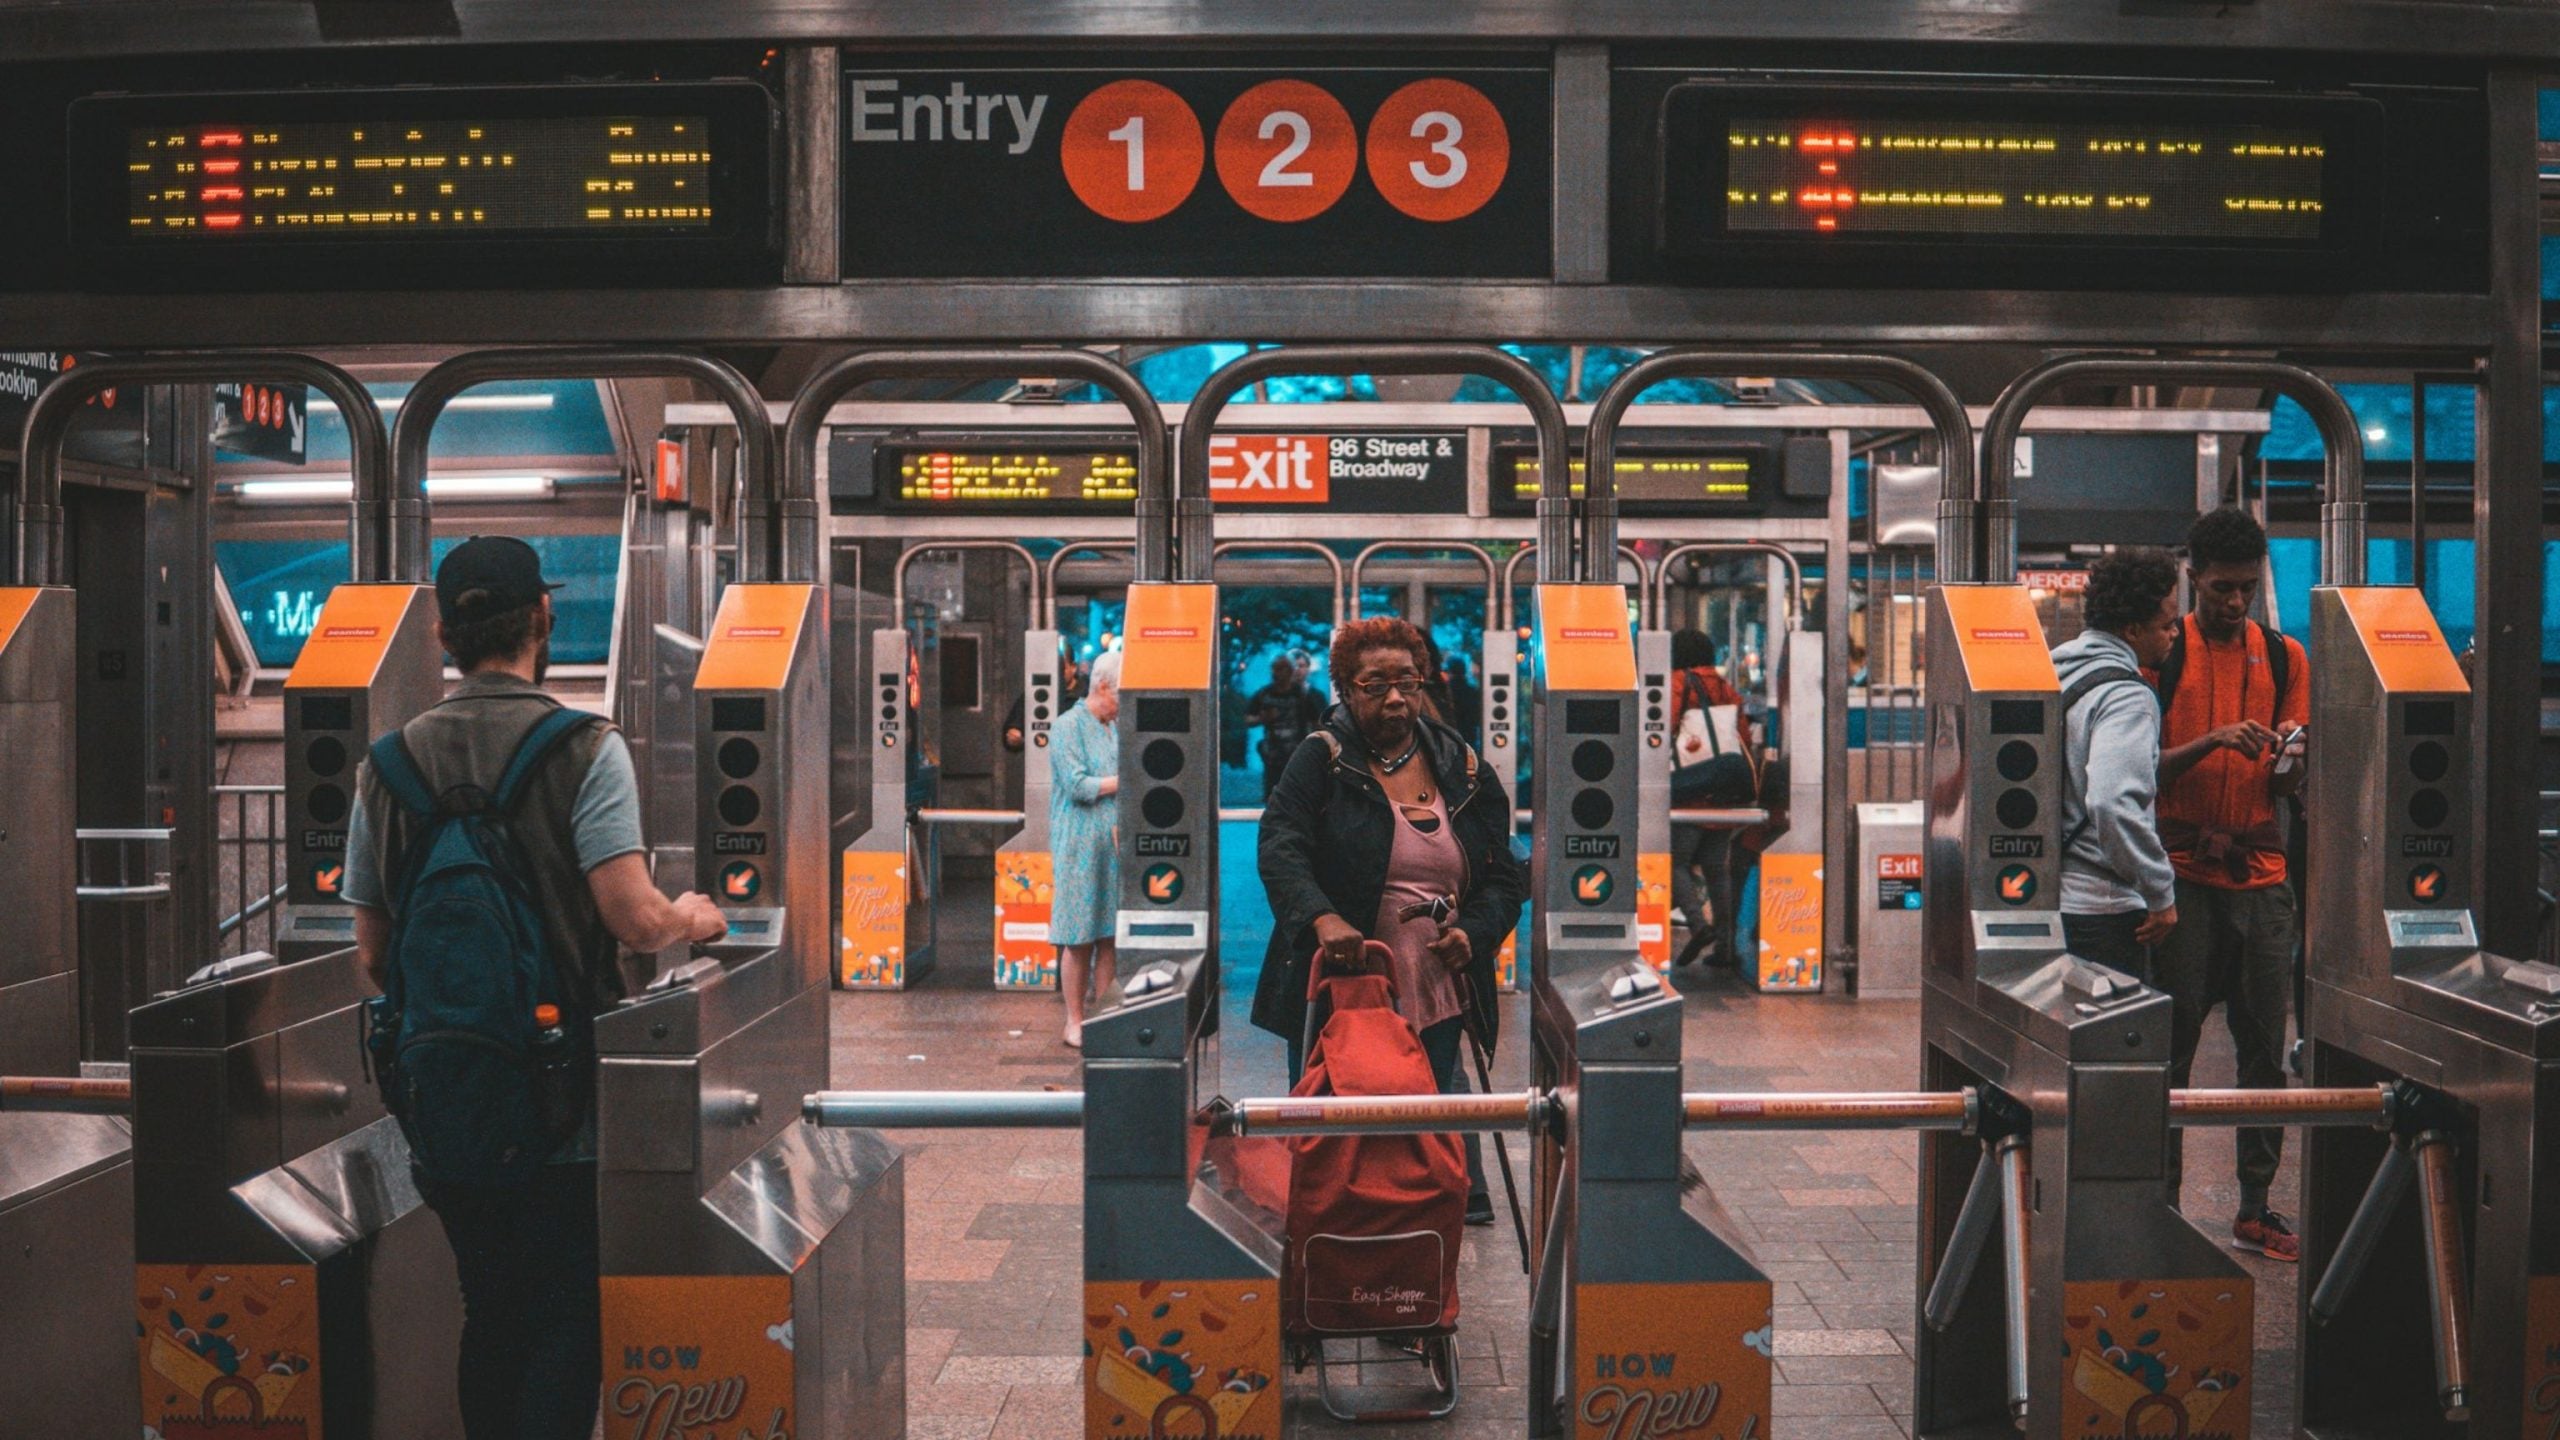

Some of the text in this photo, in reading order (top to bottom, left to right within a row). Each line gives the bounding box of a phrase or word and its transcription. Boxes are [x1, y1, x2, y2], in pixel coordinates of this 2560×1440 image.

[852, 79, 1469, 191] Entry 1 2 3
[1209, 437, 1453, 490] Exit 96 Street &
[1329, 459, 1430, 481] Broadway
[715, 834, 764, 854] Entry
[1138, 836, 1188, 856] Entry
[1567, 837, 1617, 857] Entry
[1992, 837, 2040, 857] Entry
[2404, 837, 2450, 856] Entry
[1881, 857, 1918, 875] Exit
[1334, 1106, 1383, 1117] ORDER
[1391, 1104, 1431, 1115] WITH
[1772, 1103, 1824, 1112] ORDER
[1352, 1285, 1427, 1306] Easy Shopper
[1396, 1305, 1417, 1314] GNA
[624, 1346, 700, 1370] HOW
[1596, 1354, 1675, 1378] HOW
[611, 1375, 745, 1440] New
[1580, 1381, 1720, 1440] New
